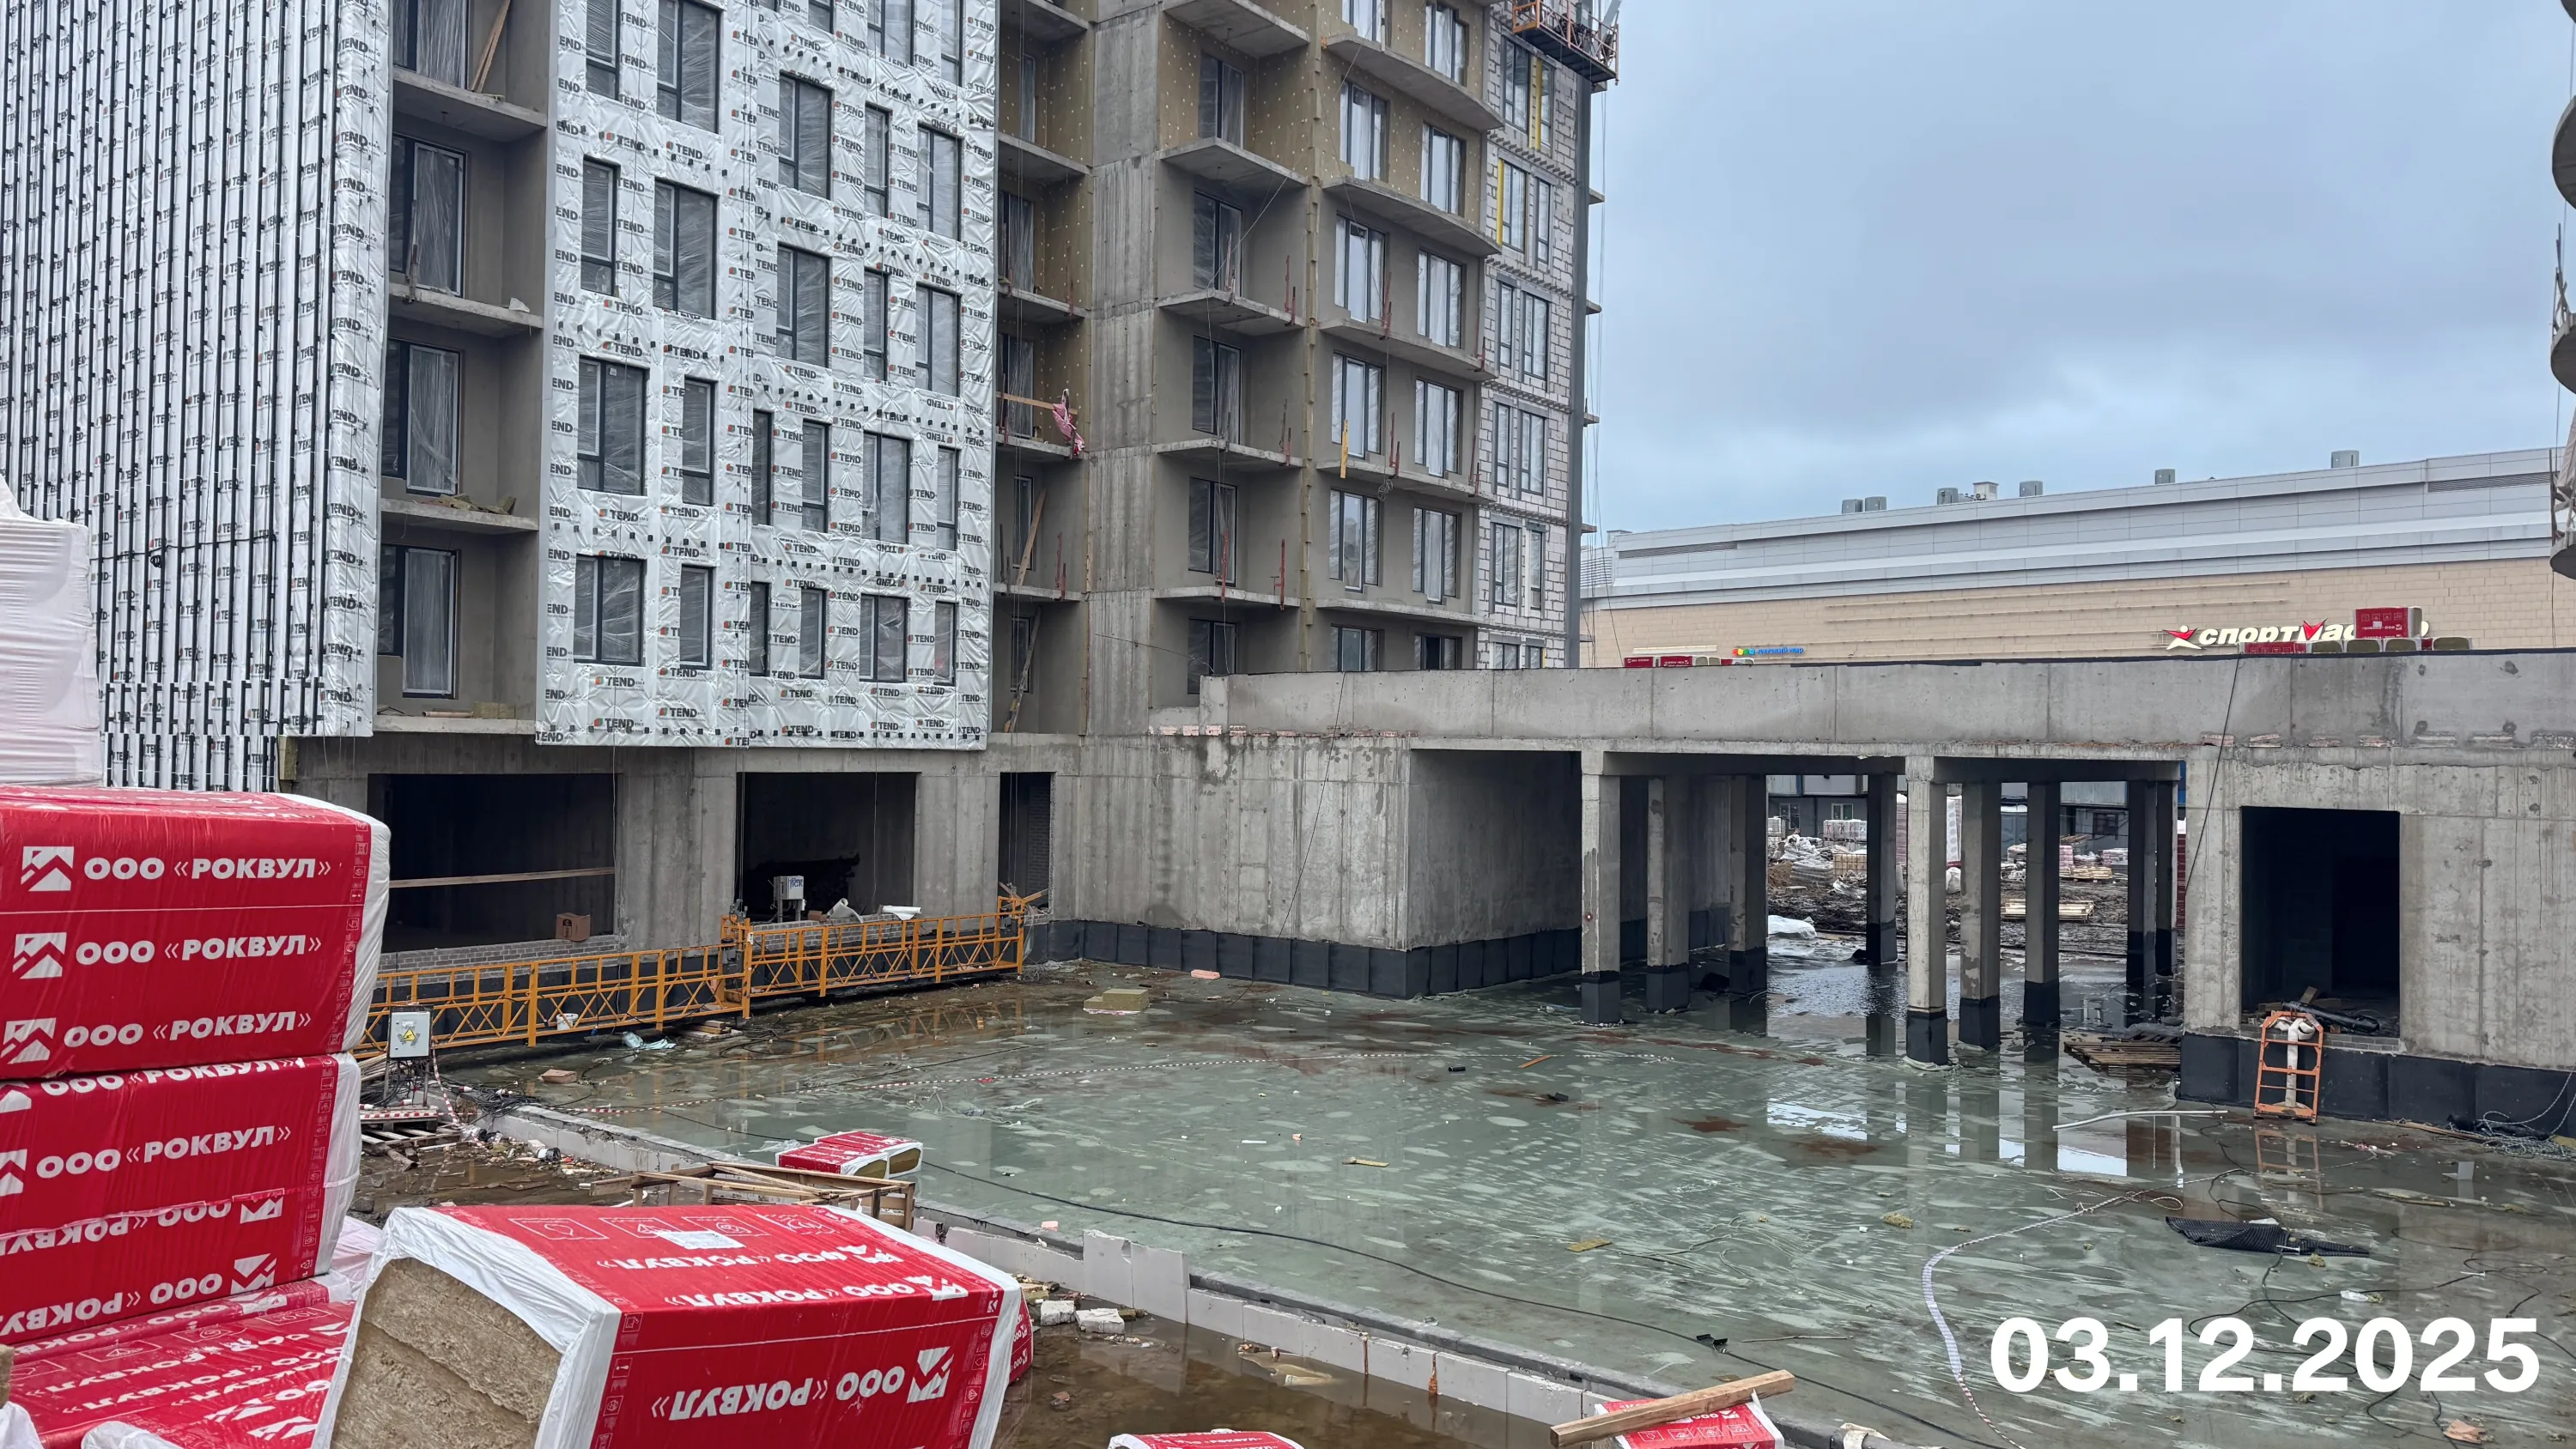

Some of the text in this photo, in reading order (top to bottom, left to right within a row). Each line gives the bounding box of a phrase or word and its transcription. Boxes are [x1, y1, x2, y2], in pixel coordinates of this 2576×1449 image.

[341, 38, 368, 52] TEND
[560, 35, 581, 51] END
[799, 37, 821, 51] TEND
[844, 33, 866, 49] TEND
[914, 54, 933, 68] TEND
[342, 84, 367, 99] TEND
[558, 78, 580, 93] END
[842, 105, 864, 118] TEND
[341, 131, 368, 146] TEND
[617, 135, 645, 151] TEND
[676, 143, 702, 159] TEND
[897, 145, 918, 158] TEND
[556, 164, 578, 178] END
[339, 178, 365, 192] TEND
[617, 178, 644, 192] TEND
[897, 179, 917, 192] TEND
[972, 178, 990, 191] TEND
[556, 207, 578, 220] END
[841, 209, 862, 221] TEND
[897, 213, 917, 227] TEND
[971, 209, 989, 222] TEND
[337, 224, 364, 238] TEND
[617, 219, 644, 233] TEND
[885, 229, 905, 243] TEND
[556, 250, 577, 263] END
[842, 245, 863, 256] TEND
[616, 261, 643, 274] TEND
[884, 264, 904, 277] TEND
[338, 270, 364, 284] TEND
[931, 274, 951, 287] TEND
[841, 278, 862, 291] TEND
[555, 292, 575, 305] END
[615, 301, 642, 315] TEND
[969, 306, 987, 319] TEND
[335, 318, 361, 330] TEND
[841, 313, 862, 325] TEND
[553, 335, 574, 347] END
[614, 343, 642, 356] TEND
[841, 348, 861, 360] TEND
[334, 363, 360, 377] TEND
[793, 367, 816, 379] TEND
[552, 378, 574, 390] END
[793, 402, 817, 414] TEND
[927, 399, 946, 409] TEND
[552, 421, 573, 432] END
[840, 418, 861, 429] TEND
[927, 433, 945, 443] TEND
[965, 436, 984, 447] TEND
[840, 452, 860, 464] TEND
[550, 464, 571, 475] END
[963, 469, 982, 479] TEND
[915, 489, 934, 499] TEND
[331, 503, 355, 517] TEND
[550, 506, 571, 518] END
[963, 501, 981, 511] TEND
[610, 509, 638, 522] TEND
[839, 523, 860, 532] TEND
[916, 523, 936, 531] TEND
[962, 534, 981, 543] TEND
[549, 549, 569, 560] END
[672, 547, 699, 557] TEND
[793, 544, 816, 554] TEND
[331, 550, 356, 563] TEND
[839, 557, 860, 567] TEND
[927, 585, 947, 593] TEND
[329, 597, 355, 609] TEND
[837, 592, 859, 601] TEND
[962, 597, 980, 607] TEND
[548, 604, 568, 614] END
[836, 627, 858, 635] TEND
[960, 629, 979, 639] TEND
[328, 643, 353, 656] TEND
[547, 646, 567, 657] END
[835, 661, 857, 670] TEND
[606, 677, 635, 687] TEND
[326, 690, 351, 702] TEND
[546, 689, 565, 699] END
[835, 695, 857, 704] TEND
[670, 707, 697, 718] TEND
[536, 731, 563, 742] TEND
[84, 857, 331, 880] ООО «РОКВУЛ»
[76, 934, 321, 965] ООО «РОКВУЛ»
[64, 1010, 312, 1047] ООО «РОКВУЛ»
[40, 1076, 125, 1096] ООО
[36, 1125, 291, 1179] ООО «РОКВУЛ»
[0, 1216, 148, 1256] «РОКВУ
[0, 1273, 223, 1336] ООО «РОКВУ
[651, 1366, 905, 1422] ООО «РОКВУЛ»
